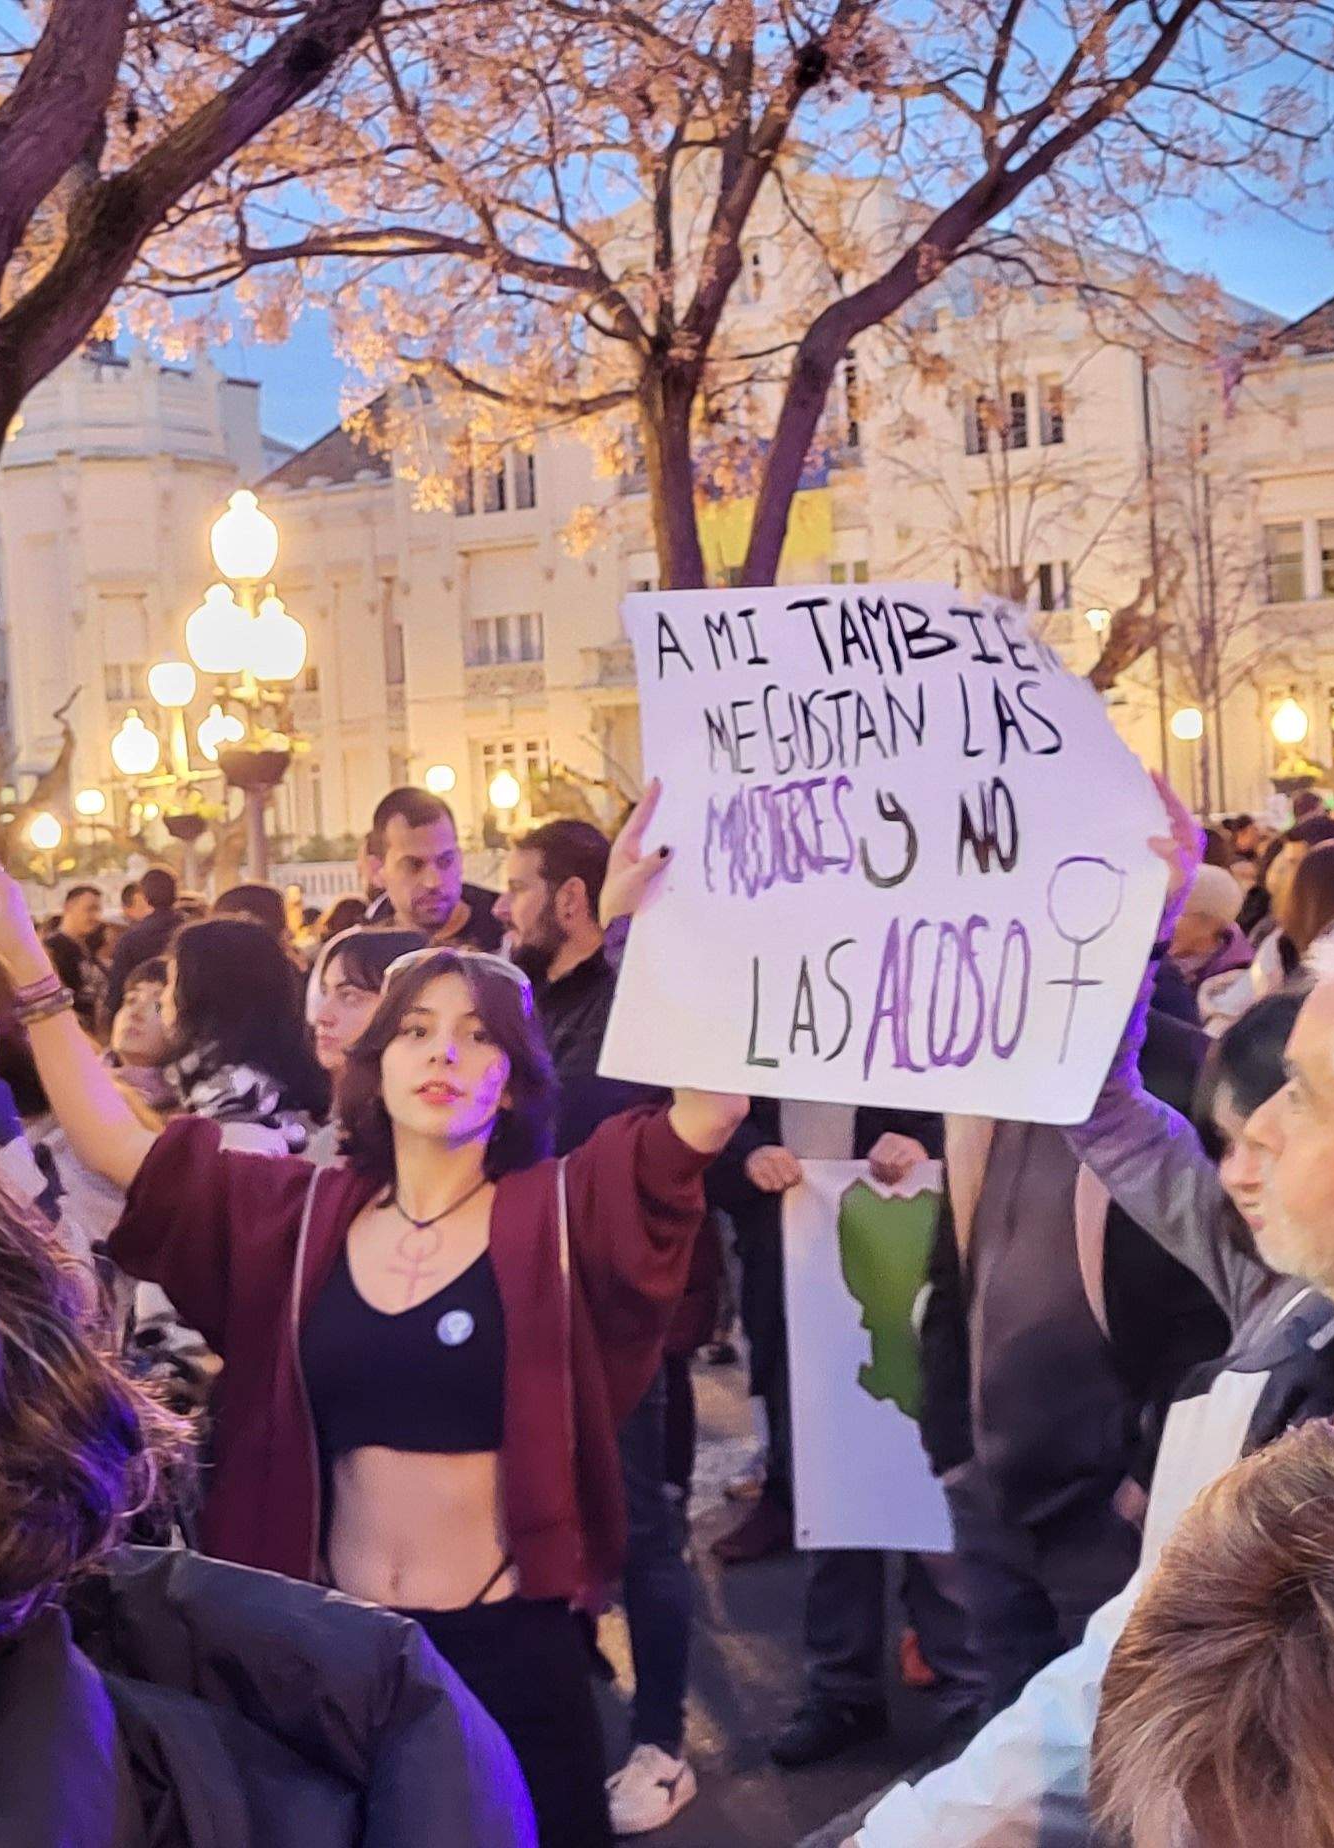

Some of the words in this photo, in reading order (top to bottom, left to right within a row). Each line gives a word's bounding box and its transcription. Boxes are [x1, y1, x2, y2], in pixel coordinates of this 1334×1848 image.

[656, 612, 694, 680] A
[703, 607, 769, 674] MI
[703, 700, 756, 775] ME
[763, 682, 927, 775] GUSTAN
[958, 673, 1063, 765] LAS
[957, 776, 1019, 877] NO
[745, 938, 858, 1069] LAS
[863, 914, 1032, 1081] ACOSO
